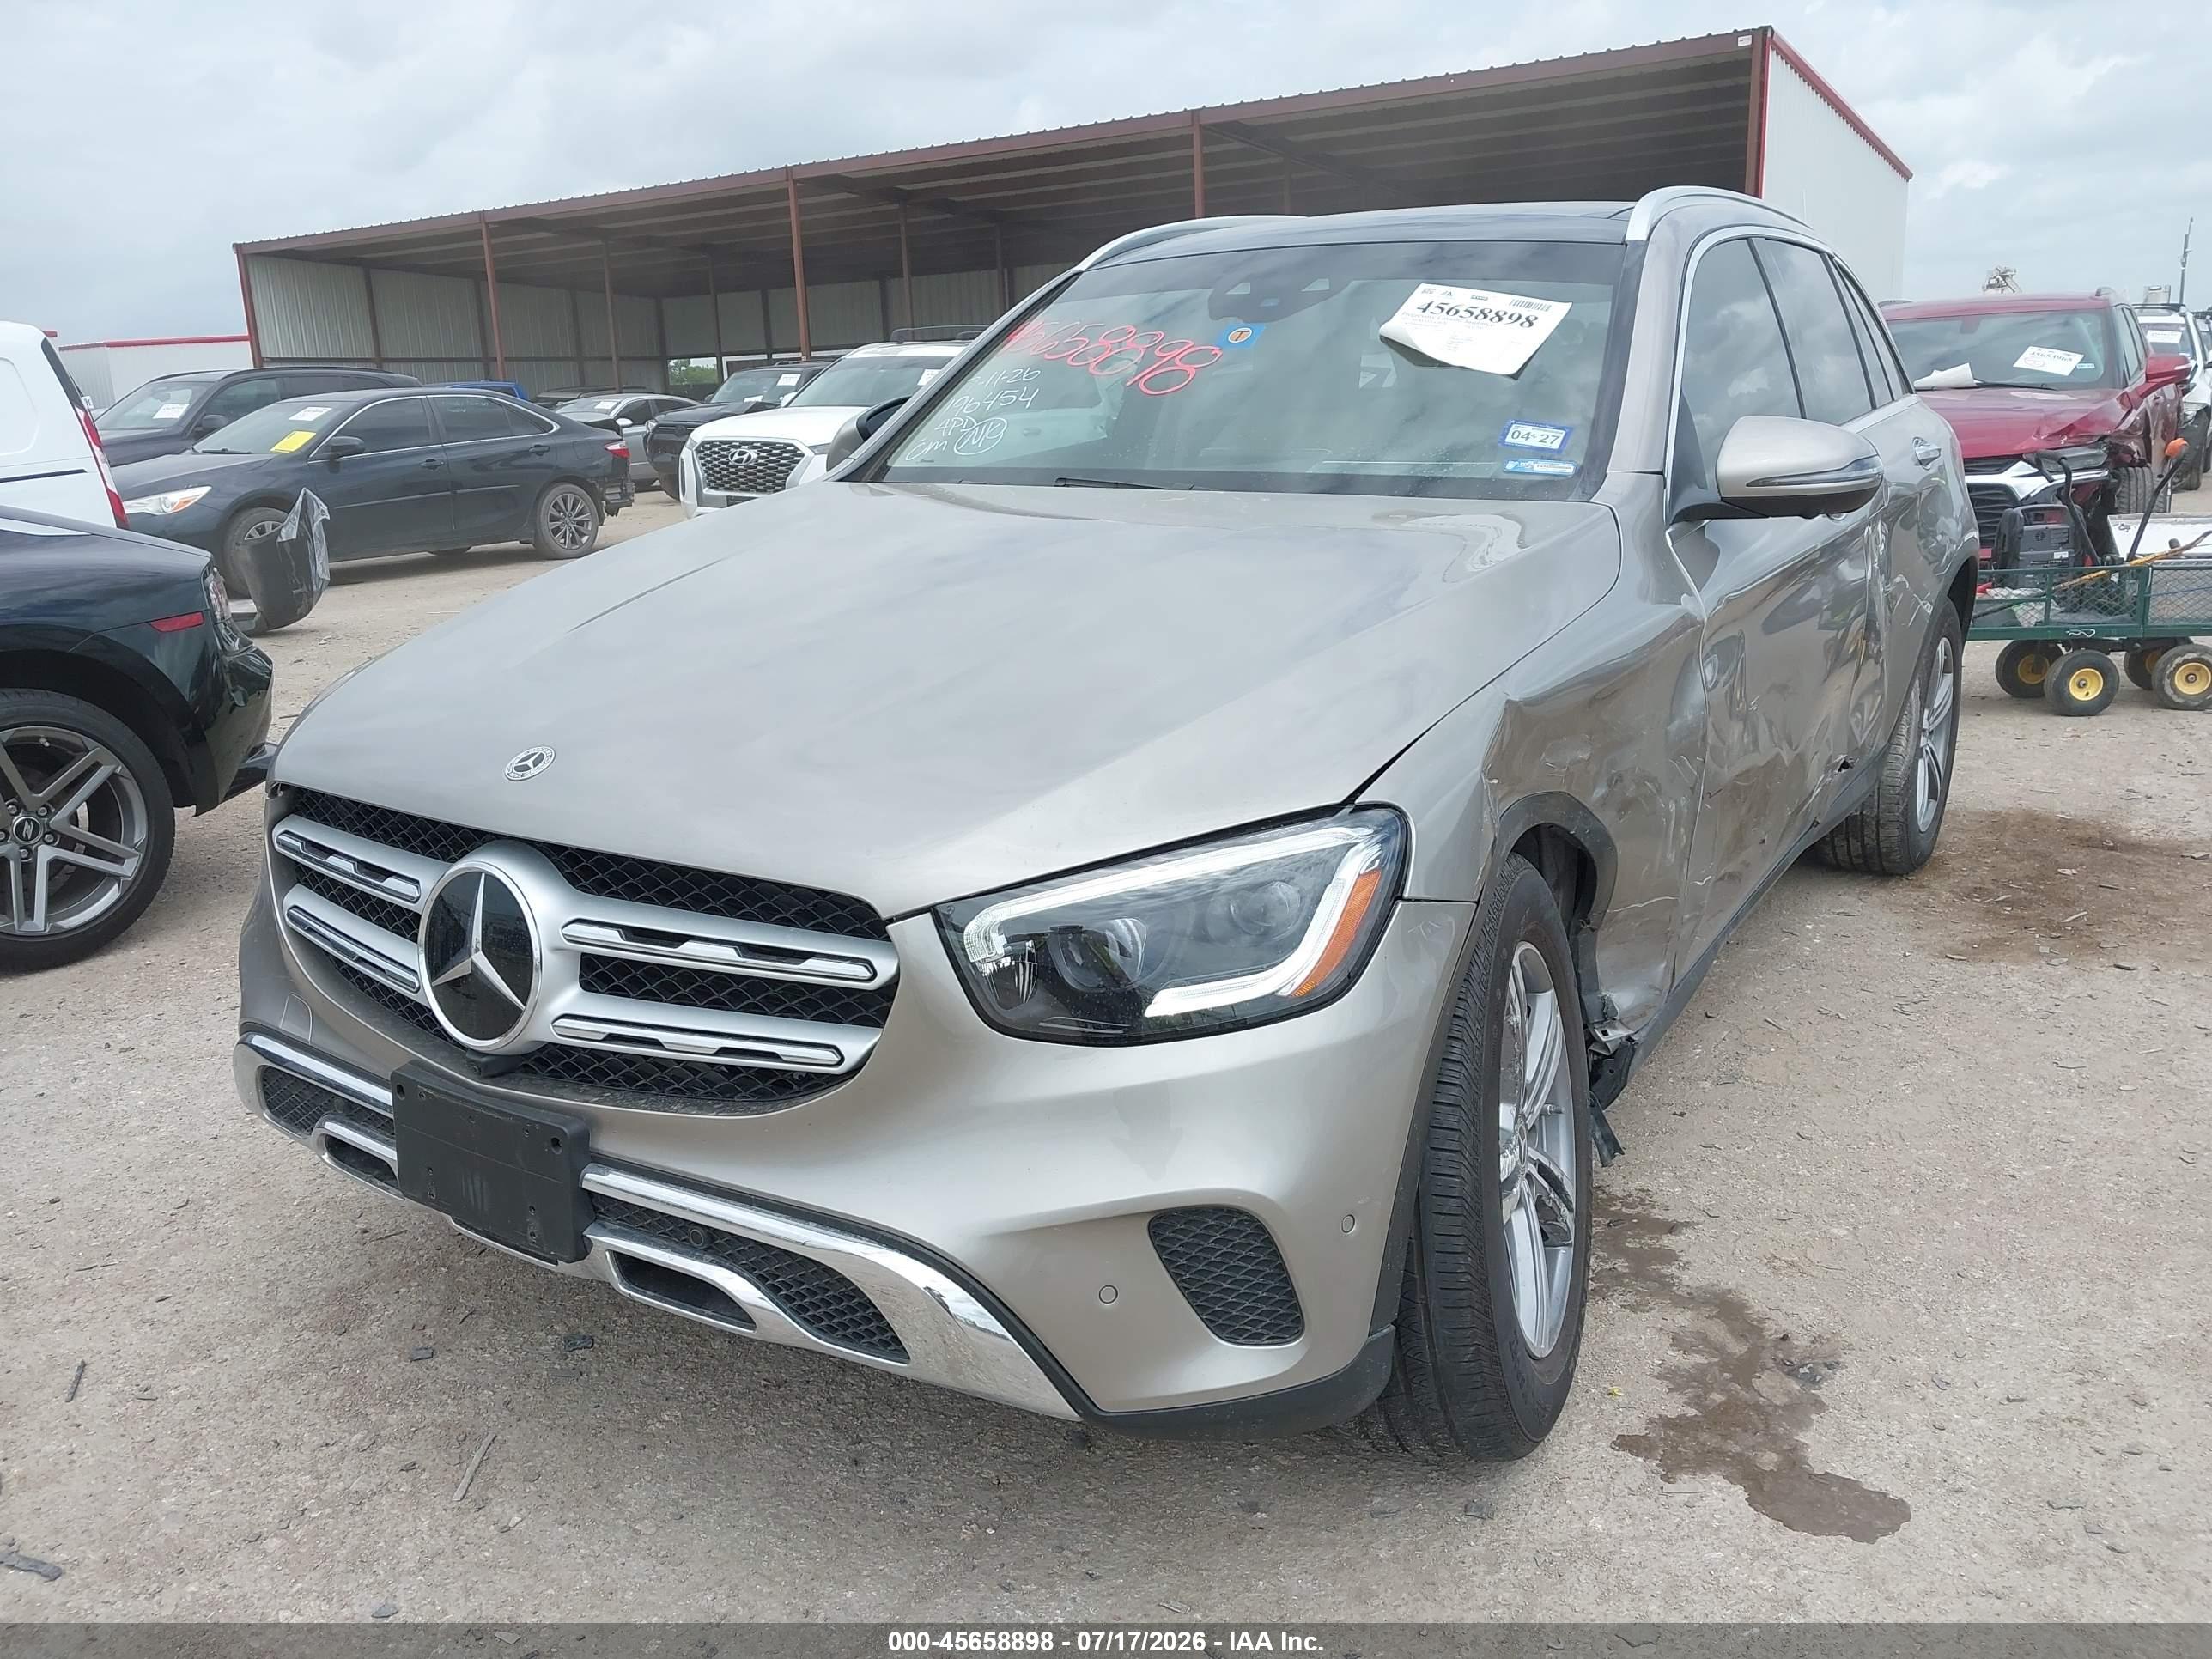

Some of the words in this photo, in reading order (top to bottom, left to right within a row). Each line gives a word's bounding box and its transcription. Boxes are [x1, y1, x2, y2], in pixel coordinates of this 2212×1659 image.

[1416, 301, 1539, 328] 45658898
[1510, 429, 1532, 441] 04
[1538, 434, 1561, 445] 27
